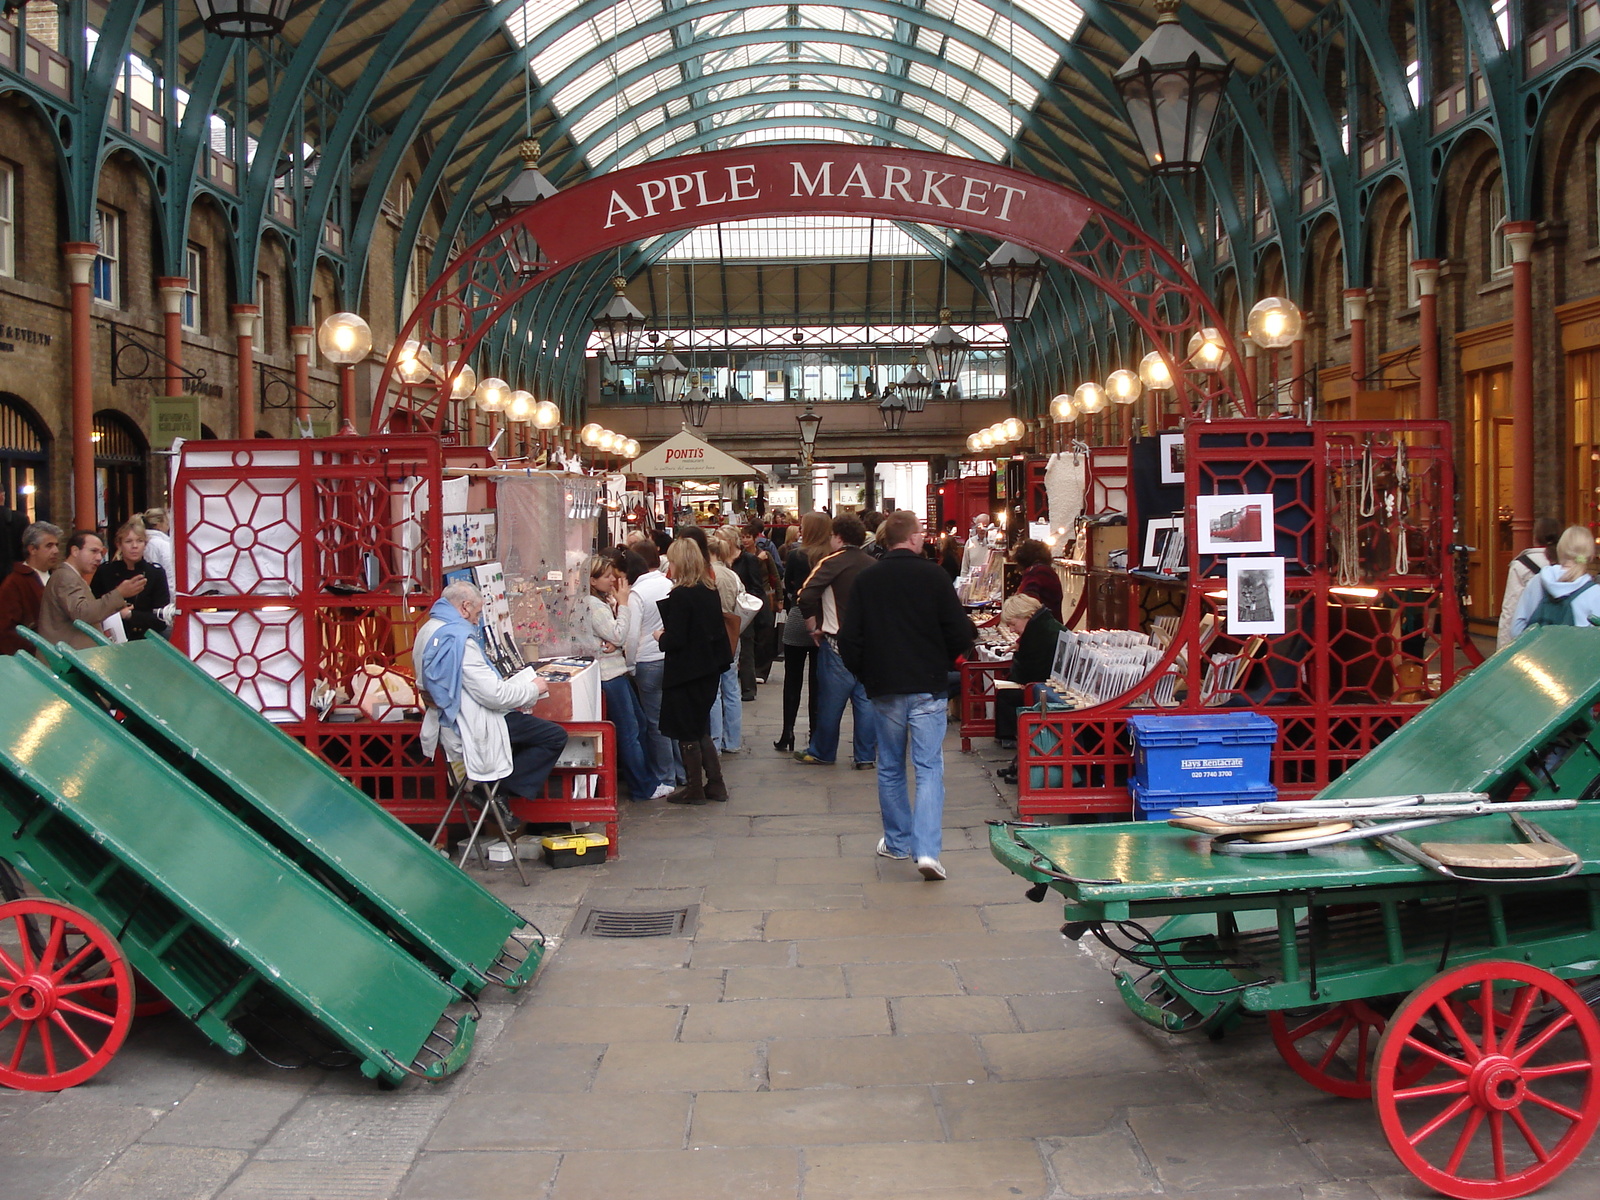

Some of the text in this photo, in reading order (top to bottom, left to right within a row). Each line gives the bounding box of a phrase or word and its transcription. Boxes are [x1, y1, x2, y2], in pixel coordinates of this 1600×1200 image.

[603, 161, 1027, 229] APPLE MARKET
[15, 327, 51, 347] EVELYN
[665, 447, 704, 463] PONTI'S
[1181, 758, 1243, 769] Hays Rentacrate
